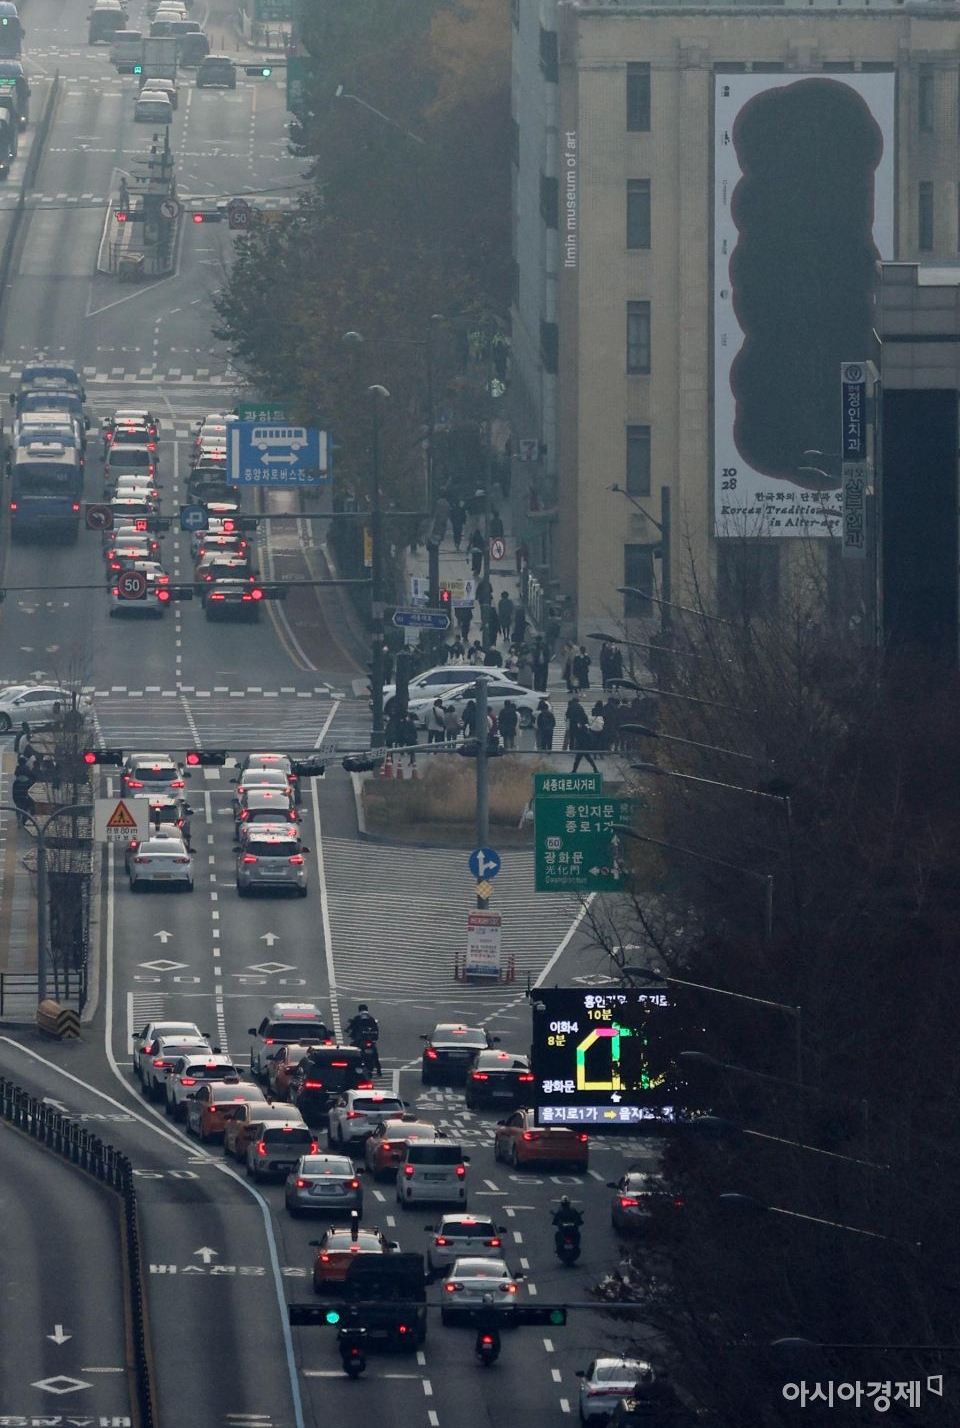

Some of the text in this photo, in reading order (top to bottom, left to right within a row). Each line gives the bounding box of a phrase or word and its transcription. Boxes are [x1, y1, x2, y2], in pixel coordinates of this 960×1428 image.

[564, 129, 577, 269] ilmin museum of art
[233, 213, 247, 224] 50
[847, 392, 861, 452] 정인치과
[721, 467, 738, 478] 10
[721, 478, 738, 491] 28
[721, 505, 763, 516] Korean
[770, 517, 782, 527] in
[124, 578, 140, 591] 50
[542, 778, 596, 791] 세종대로사거리
[564, 804, 615, 818] 흥인지문
[544, 850, 585, 864] 광화문
[544, 864, 580, 876] 光化門
[587, 1008, 613, 1021] 10분
[549, 1020, 579, 1035] 이화4
[547, 1034, 567, 1047] 8분
[541, 1079, 576, 1094] 광화문
[541, 1107, 598, 1121] 을지로1가
[508, 1176, 583, 1185] 50
[149, 1264, 265, 1276] 버스전용
